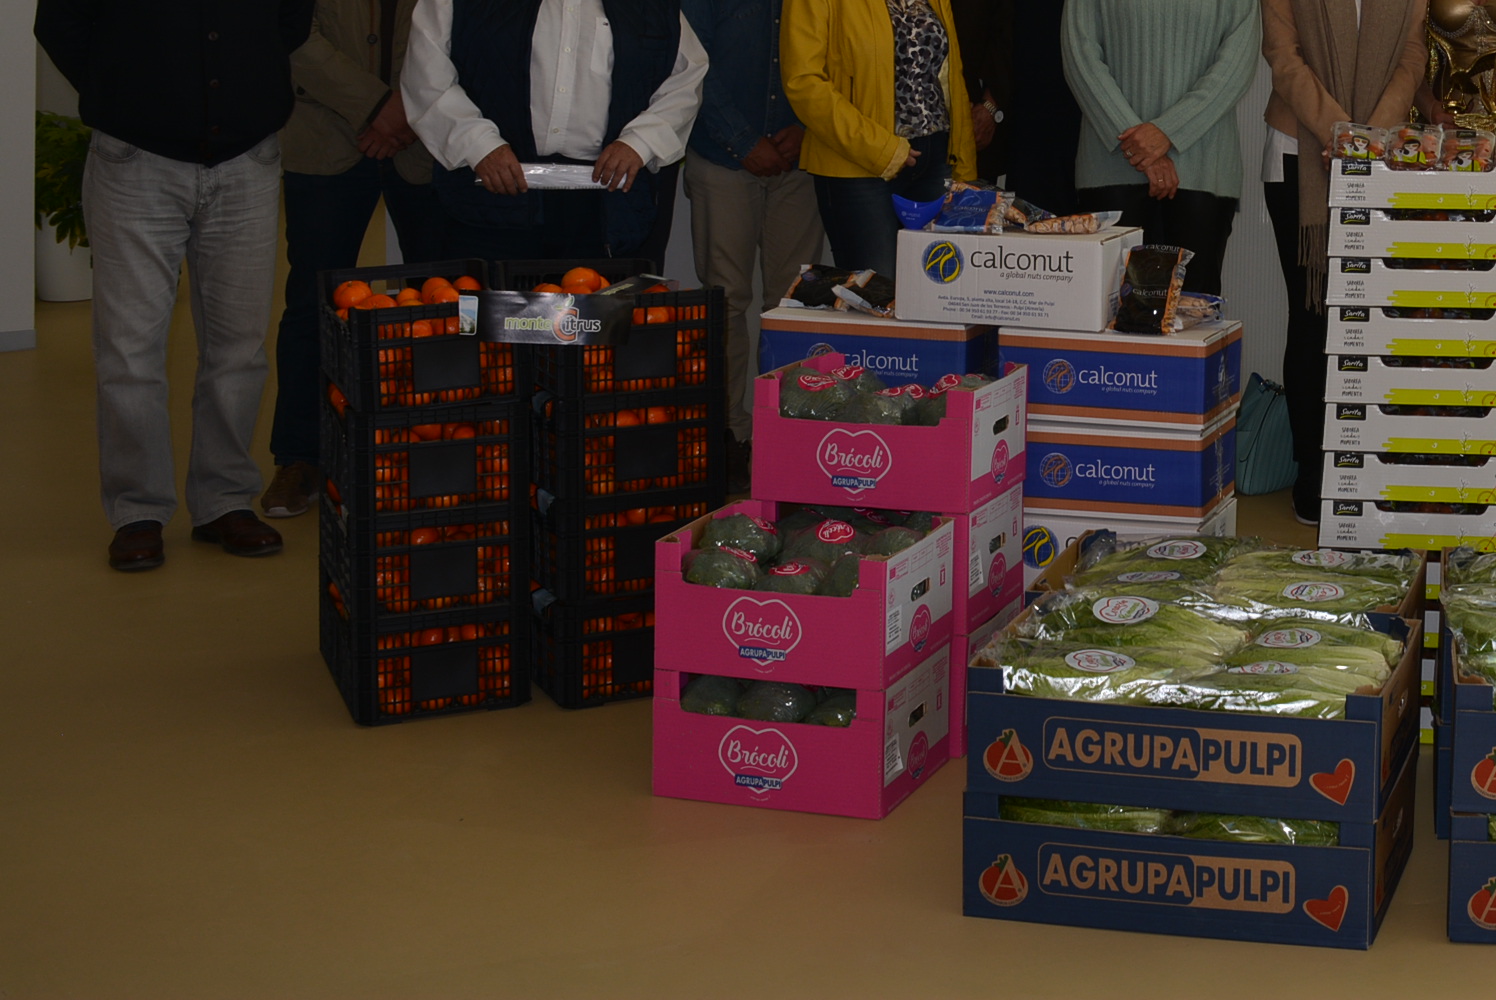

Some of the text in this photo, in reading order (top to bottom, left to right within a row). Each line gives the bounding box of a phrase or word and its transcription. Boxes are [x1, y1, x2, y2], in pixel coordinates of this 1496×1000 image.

[970, 245, 1074, 273] calconut
[1006, 271, 1027, 280] global
[1043, 274, 1073, 283] company
[984, 289, 1034, 297] www.calconut.com
[1132, 287, 1168, 297] calconut
[1078, 365, 1158, 388] calconut
[825, 442, 883, 468] Brócoli
[833, 476, 876, 488] AGRUPAPULPI
[1075, 459, 1155, 482] calconut
[731, 611, 793, 640] Brócoli
[740, 647, 786, 660] AGRUPAPULPI
[727, 739, 789, 769] Brócoli
[1047, 727, 1296, 777] AGRUPAPULPI
[735, 775, 782, 788] AGRUPAPULPI
[1042, 852, 1290, 904] AGRUPAPULPI
